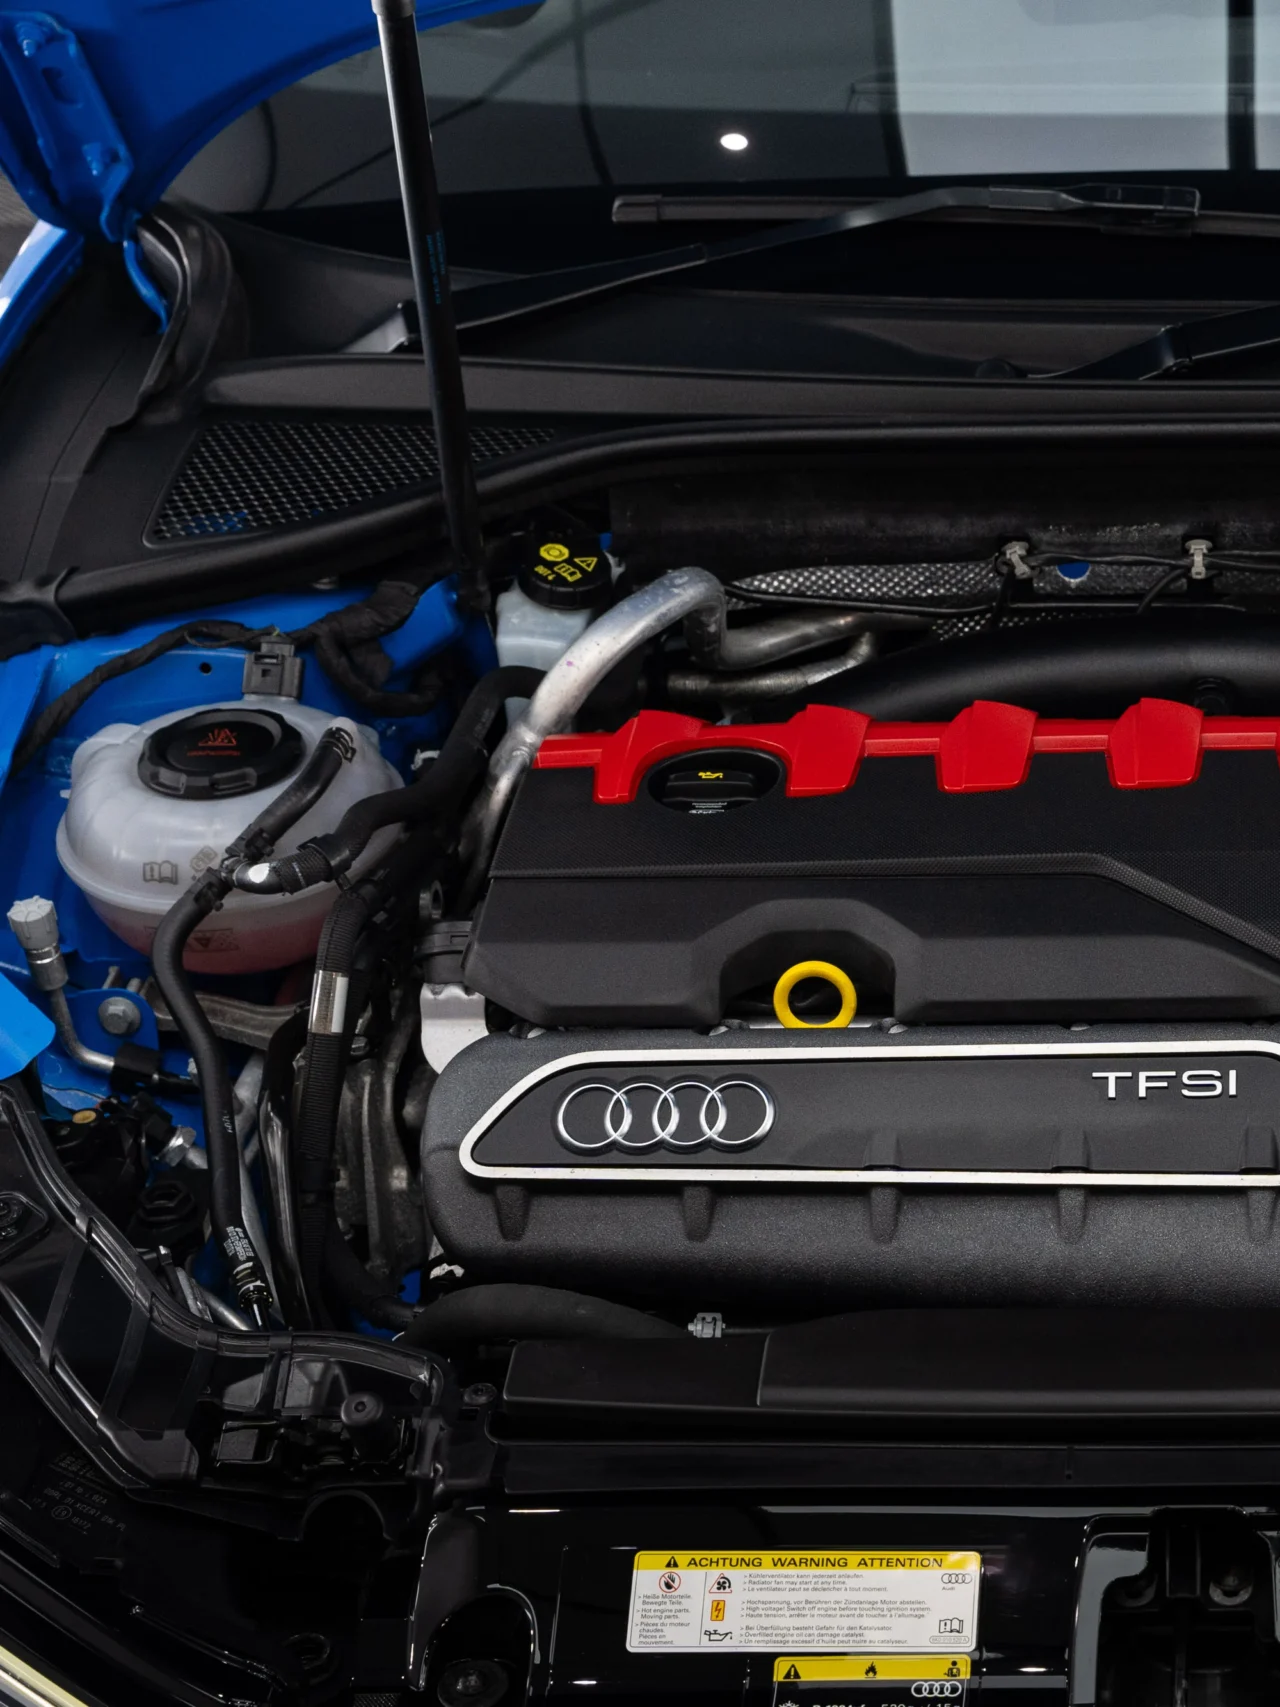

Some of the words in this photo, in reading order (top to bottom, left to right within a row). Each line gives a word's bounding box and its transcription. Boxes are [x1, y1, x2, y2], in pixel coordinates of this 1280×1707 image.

[1092, 1069, 1237, 1098] TFSI
[687, 1558, 762, 1567] ACHTUNG
[772, 1558, 848, 1567] WARNING
[857, 1557, 943, 1568] ATTENTION
